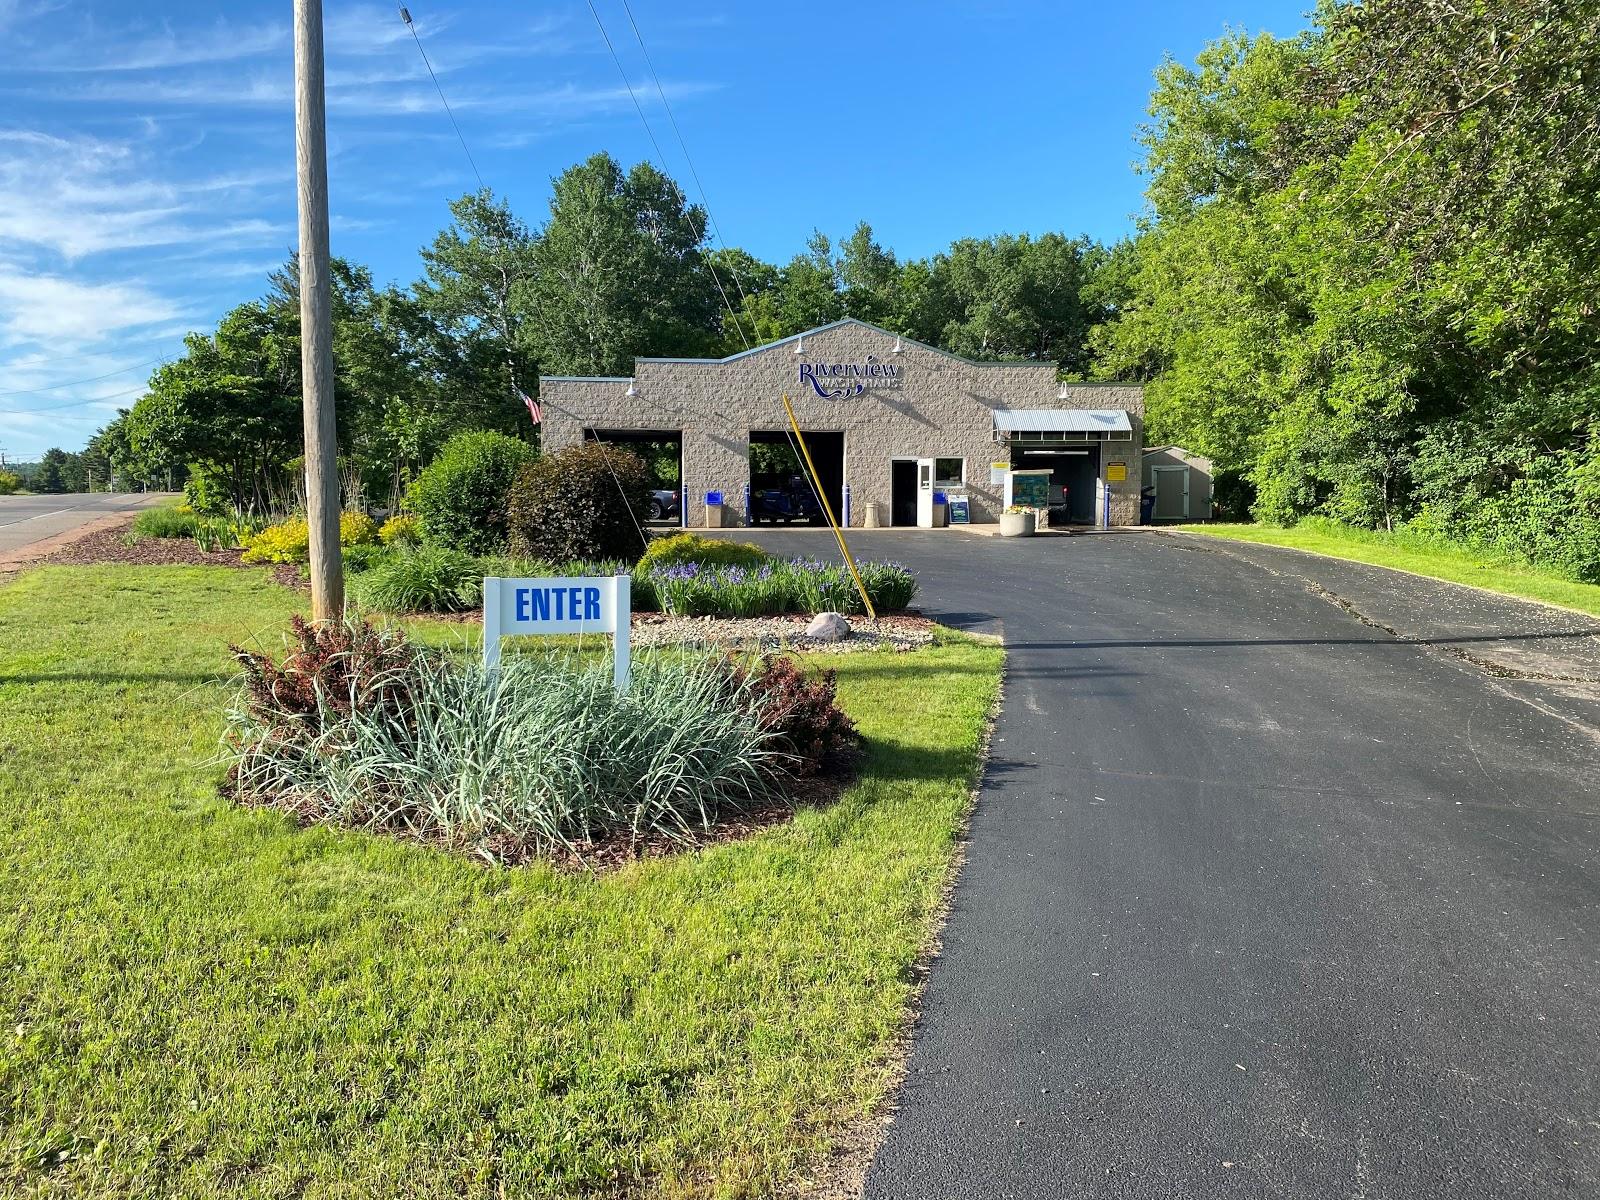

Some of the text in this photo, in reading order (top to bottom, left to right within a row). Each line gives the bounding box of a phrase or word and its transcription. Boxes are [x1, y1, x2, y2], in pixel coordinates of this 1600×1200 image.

[799, 355, 899, 398] Riverview
[818, 378, 855, 388] WASH
[516, 587, 600, 622] ENTER
